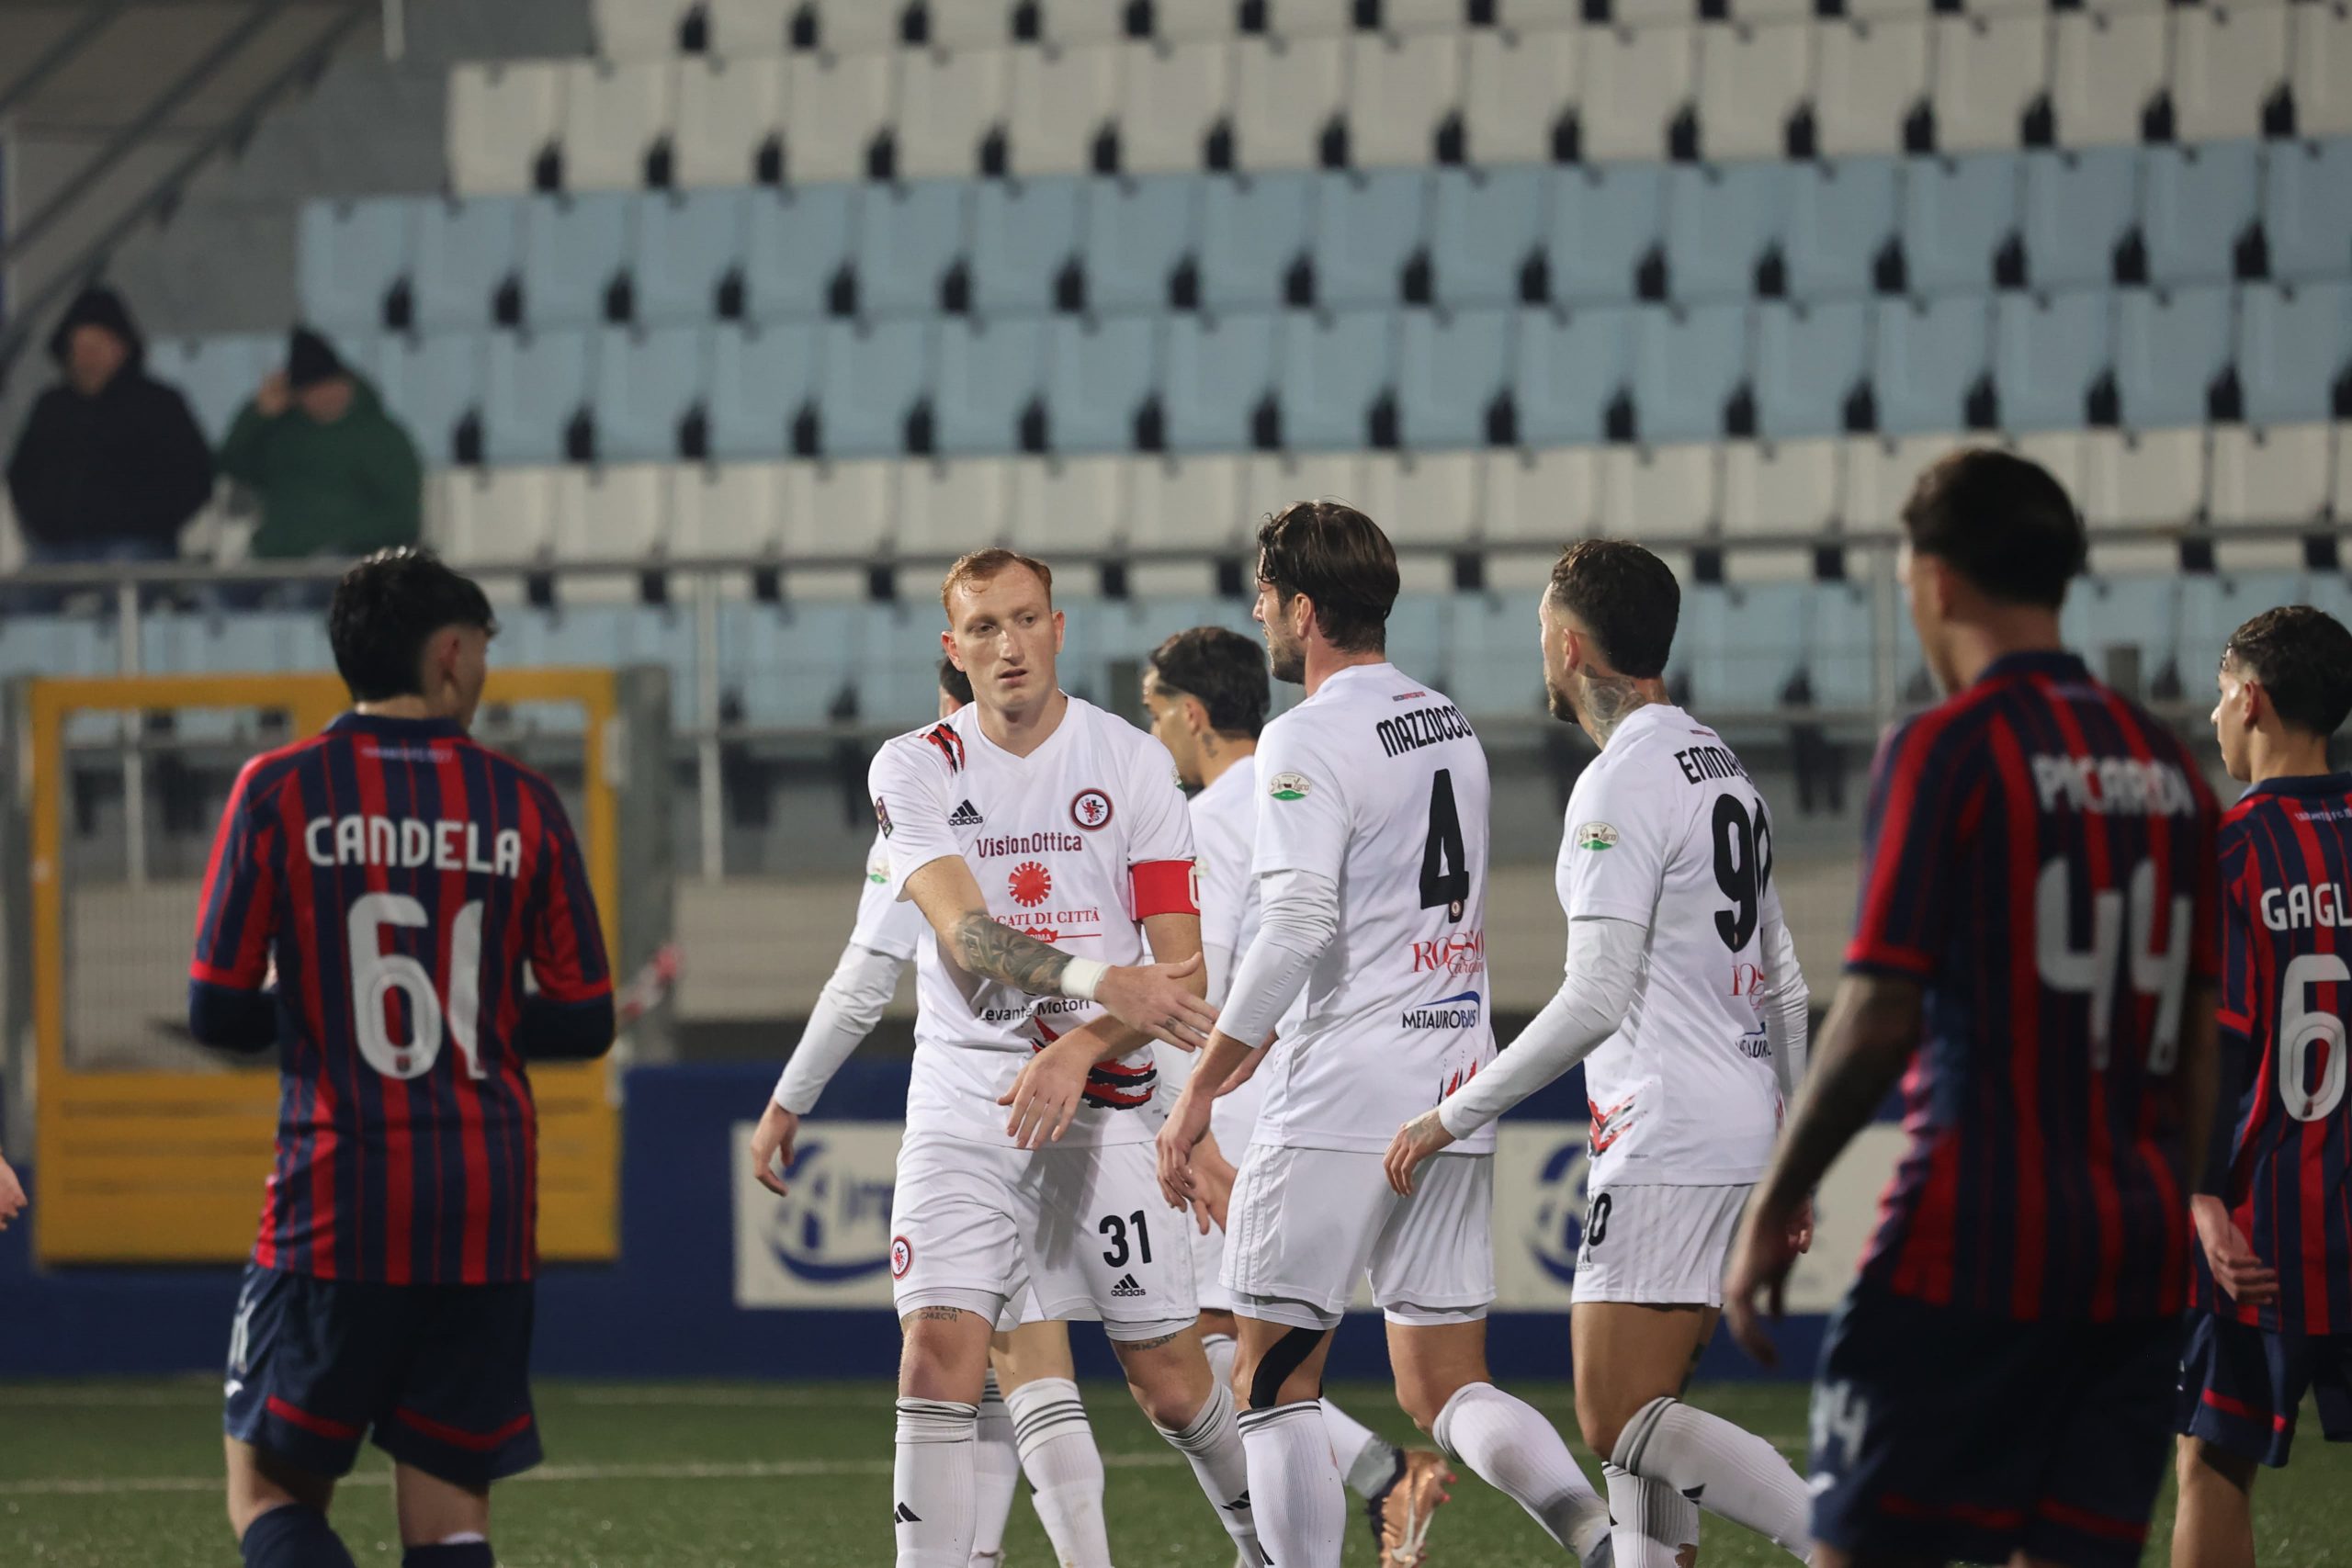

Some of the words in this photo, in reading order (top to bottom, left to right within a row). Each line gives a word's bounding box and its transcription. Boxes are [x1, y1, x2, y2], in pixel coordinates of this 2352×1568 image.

[1376, 705, 1473, 758] MAZZOCCO
[1674, 746, 1750, 785] EMMA
[948, 816, 984, 827] adidas
[977, 832, 1082, 858] VisionOttica
[1419, 768, 1469, 923] 4
[305, 815, 521, 879] CANDELA
[1713, 794, 1772, 953] 90
[993, 914, 1030, 926] CATI
[1035, 912, 1052, 924] DI
[1057, 907, 1100, 923] CITTÀ
[2260, 883, 2352, 931] GAGL
[1408, 929, 1484, 972] ROSSO
[2035, 856, 2194, 1075] 44
[347, 892, 488, 1080] 61
[1037, 998, 1090, 1016] Motori
[2279, 954, 2350, 1122] 6
[1099, 1210, 1151, 1268] 31
[1111, 1289, 1146, 1297] adidas
